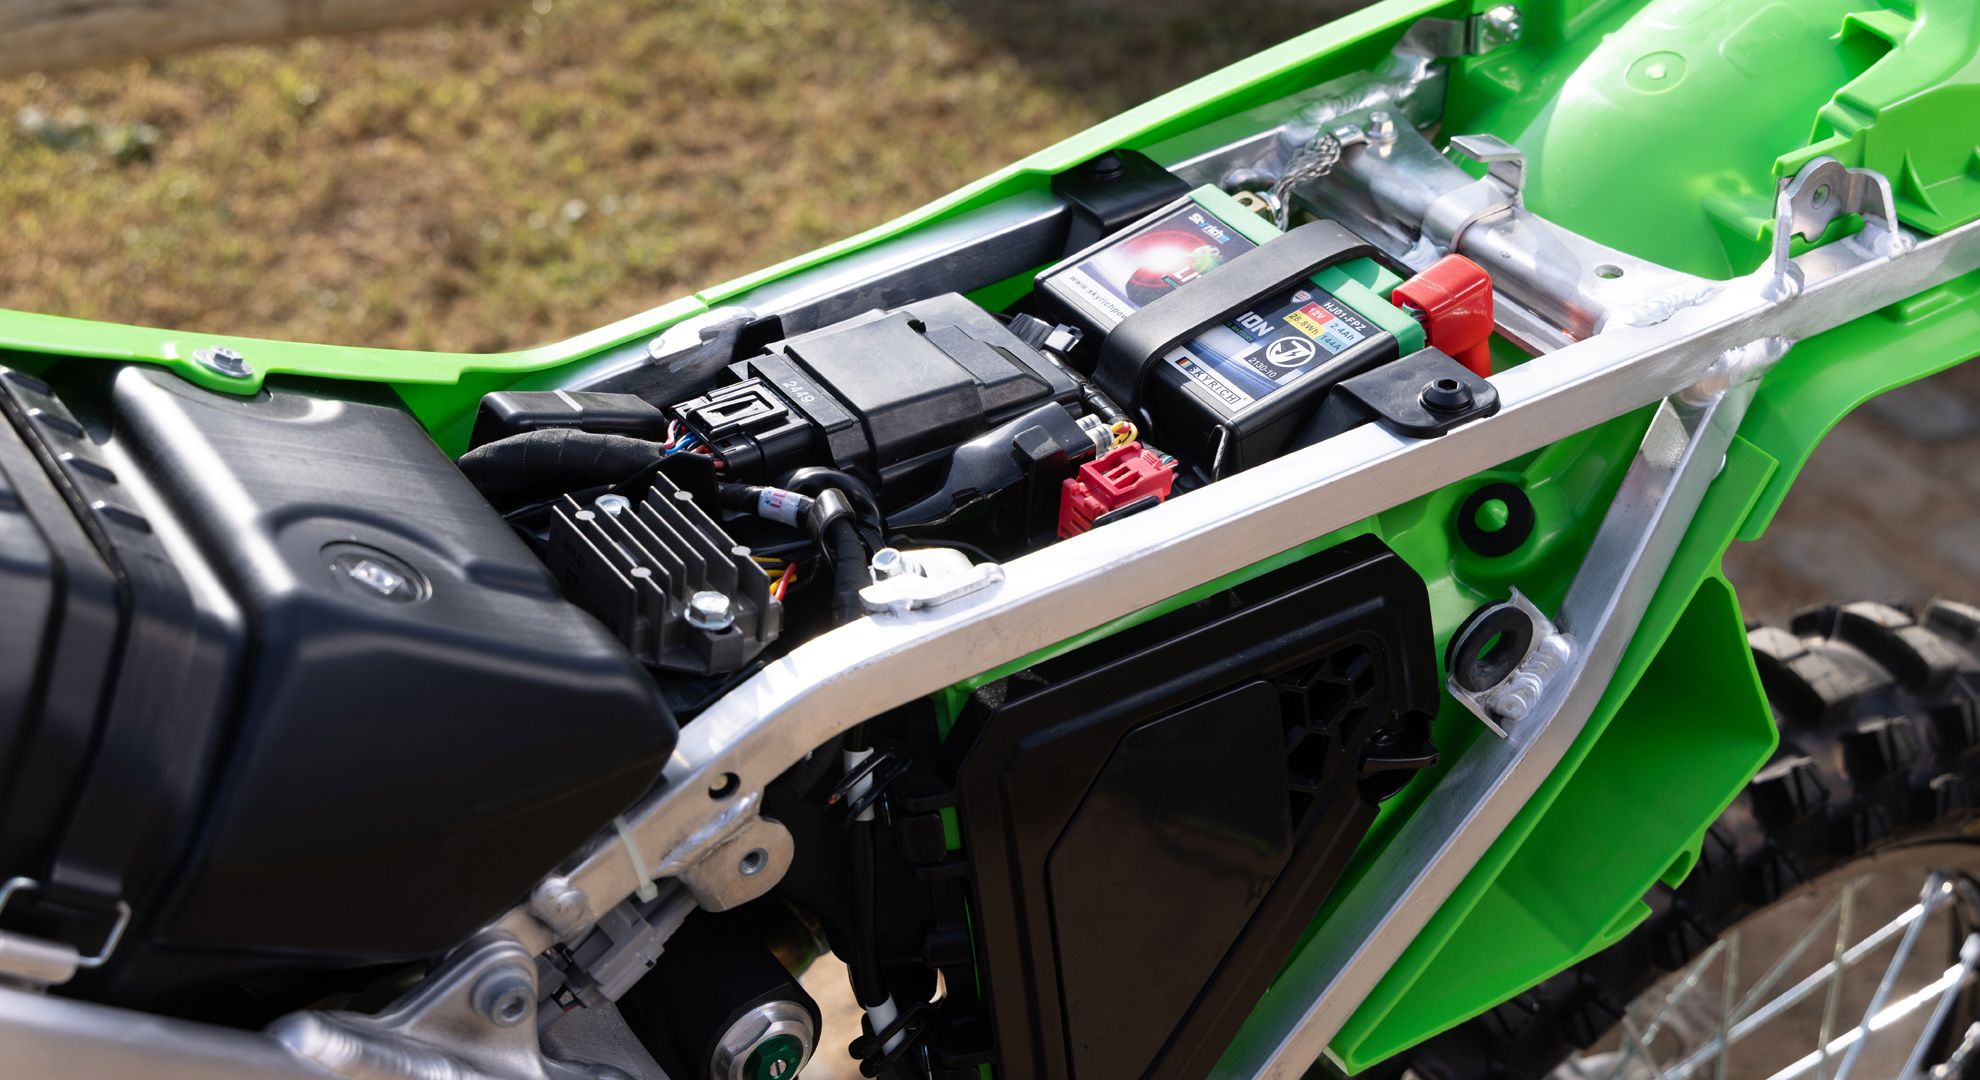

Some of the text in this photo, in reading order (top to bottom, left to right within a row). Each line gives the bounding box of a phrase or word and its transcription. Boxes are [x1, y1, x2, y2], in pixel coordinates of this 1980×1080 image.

[1172, 266, 1201, 282] LI
[1307, 307, 1326, 319] 12V
[1323, 301, 1366, 331] HJ01-FPZ
[1236, 311, 1275, 337] ION
[1289, 313, 1319, 335] 28.8Wh
[1329, 323, 1355, 341] 2.4Ah
[1320, 335, 1342, 351] 144A
[1247, 357, 1277, 378] 2130-10
[1189, 366, 1238, 403] SKYRICH
